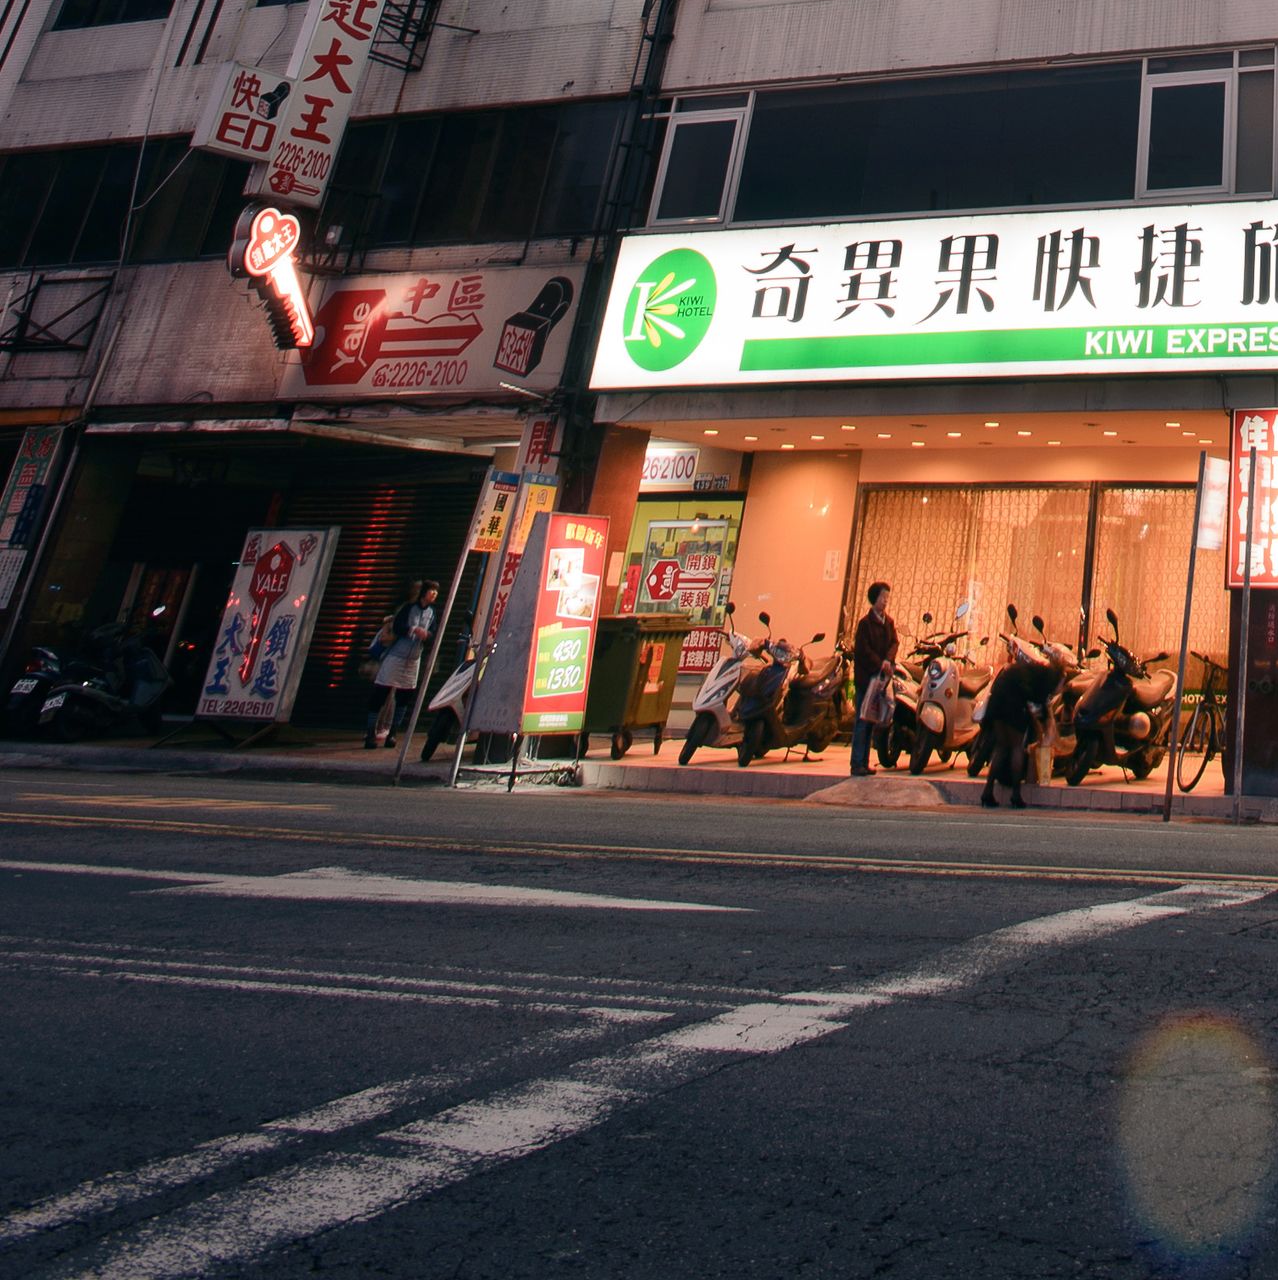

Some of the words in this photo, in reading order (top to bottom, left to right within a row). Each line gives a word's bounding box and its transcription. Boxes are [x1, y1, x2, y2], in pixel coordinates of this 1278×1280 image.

[215, 70, 277, 153] 快印
[273, 141, 331, 181] 2226-2100
[251, 223, 295, 269] 鎖匙大王
[403, 275, 483, 314] 中區
[679, 295, 704, 307] KIWI
[676, 306, 713, 319] HOTEL
[330, 303, 371, 374] Yale
[1085, 328, 1154, 356] KIWI
[686, 554, 718, 571] 開鎖
[256, 574, 288, 592] YALE
[553, 639, 582, 662] 430
[547, 665, 582, 690] 1380
